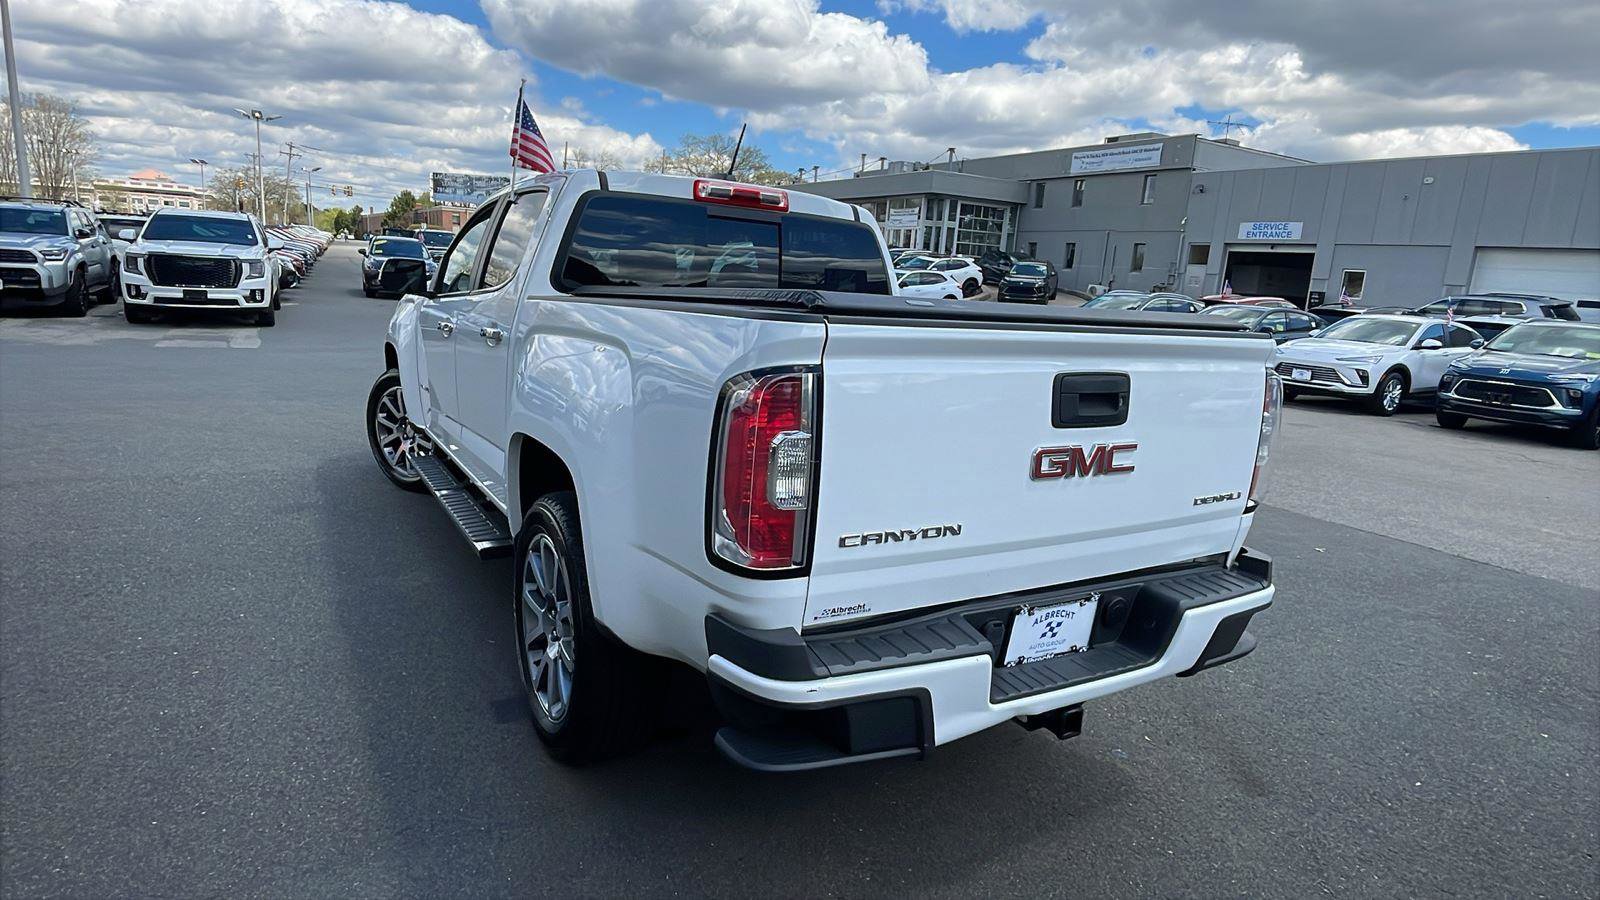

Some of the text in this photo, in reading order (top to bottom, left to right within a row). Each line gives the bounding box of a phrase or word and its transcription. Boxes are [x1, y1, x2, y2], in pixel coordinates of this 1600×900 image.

[1252, 223, 1289, 231] SERVICE
[1246, 231, 1293, 239] ENTRANCE
[1029, 442, 1138, 481] GMC
[1193, 492, 1241, 506] DENALI
[838, 523, 962, 548] CANYON
[830, 604, 866, 614] Albrecht
[1032, 609, 1076, 627] ALBRECHT
[1029, 639, 1067, 650] AUTO GROUP
